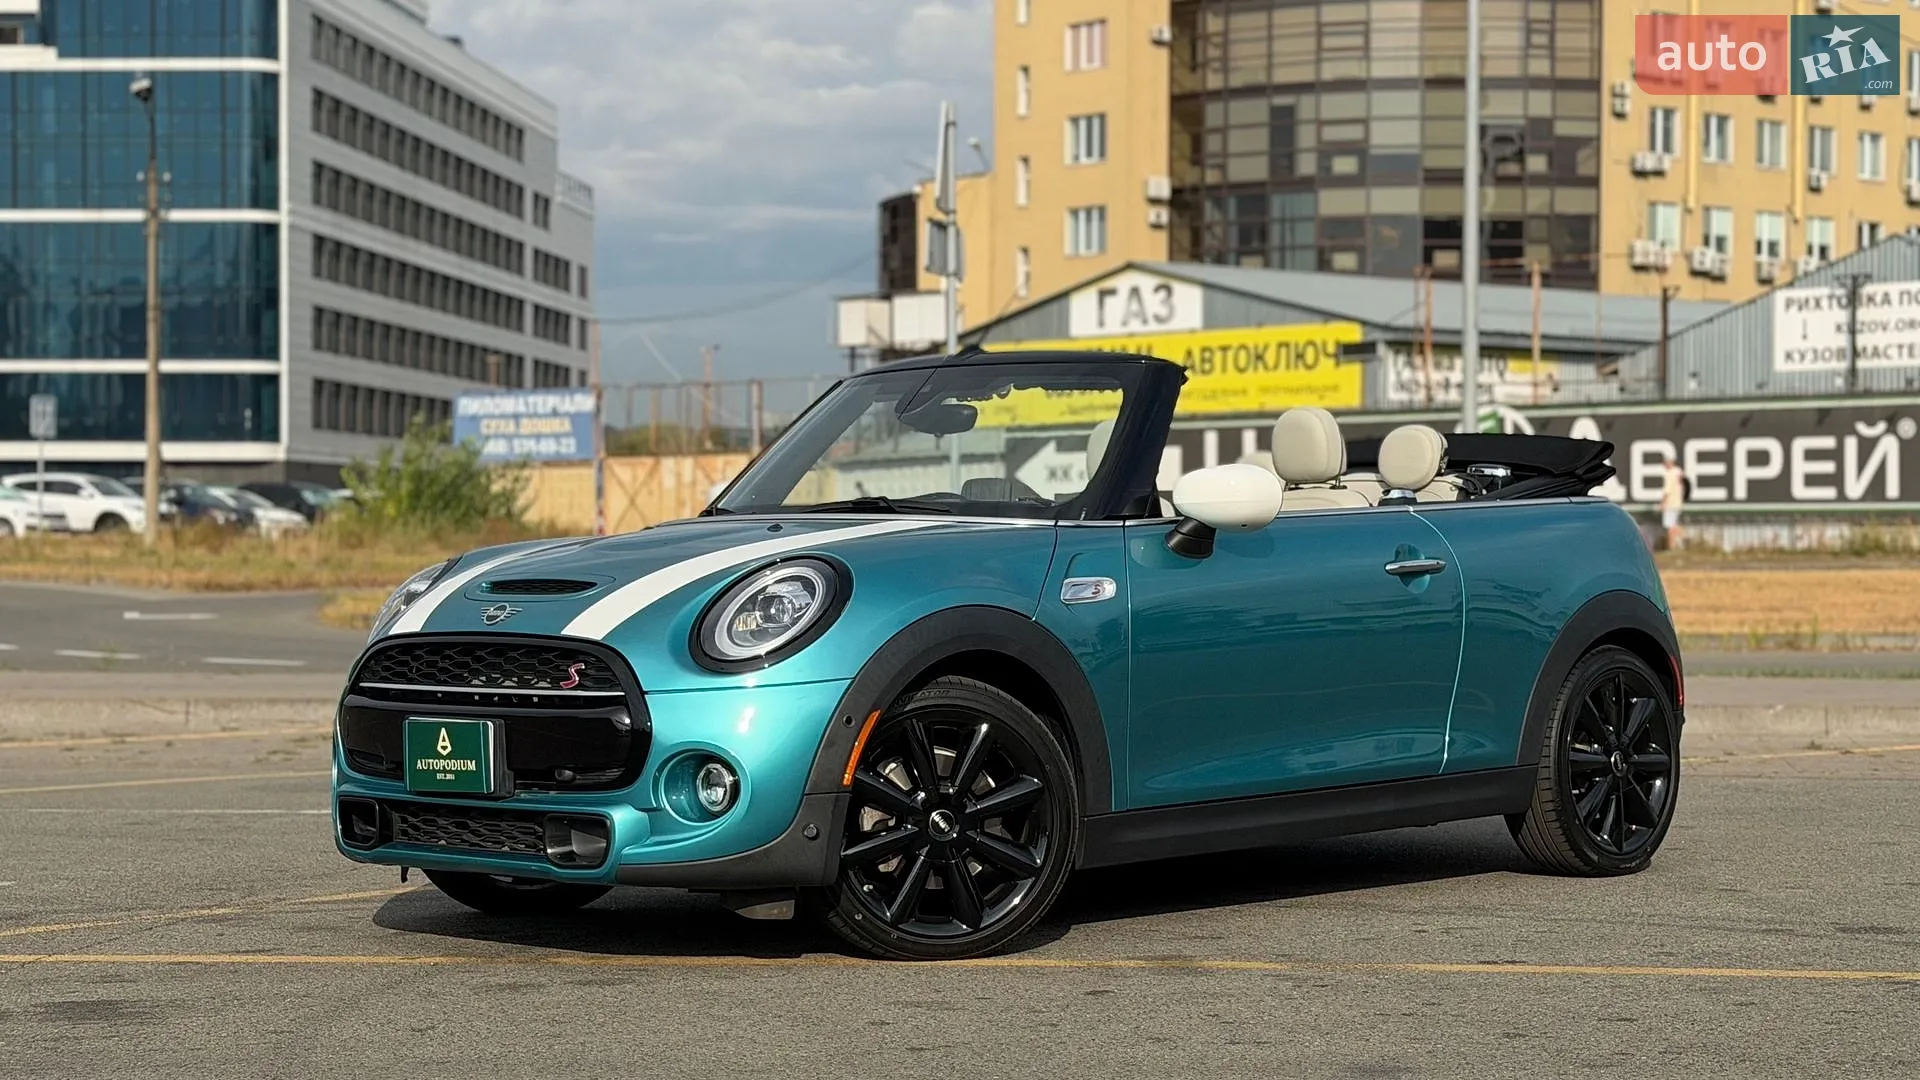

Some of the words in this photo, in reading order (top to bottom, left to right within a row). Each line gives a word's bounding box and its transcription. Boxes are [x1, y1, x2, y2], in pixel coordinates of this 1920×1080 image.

[1097, 283, 1175, 328] ГАЗ
[1784, 291, 1892, 312] РИХТОКА
[416, 758, 477, 771] AUTOPODIUM
